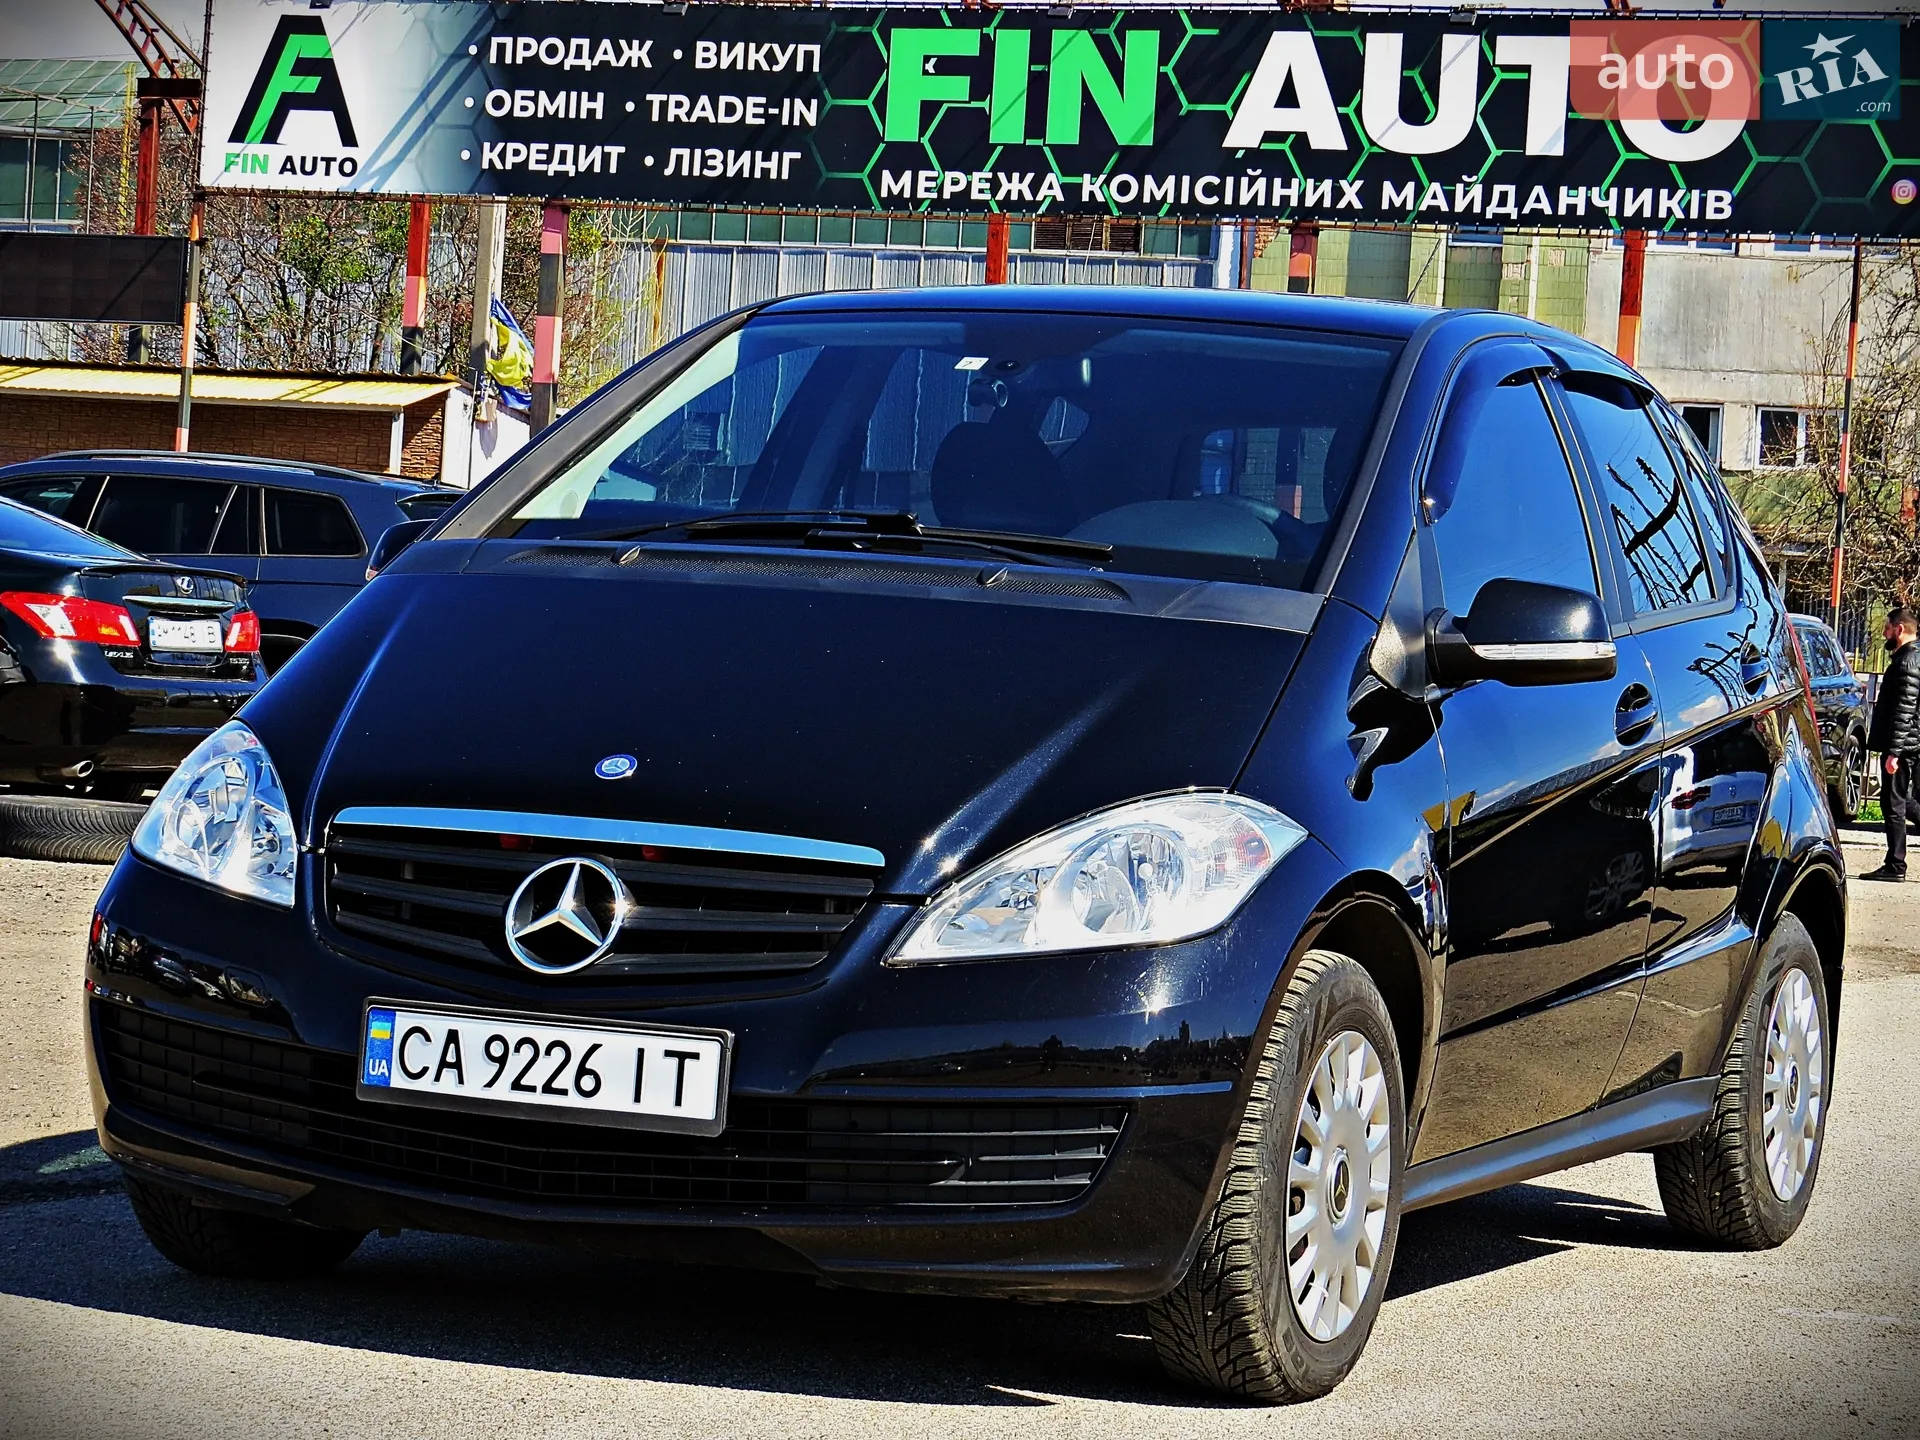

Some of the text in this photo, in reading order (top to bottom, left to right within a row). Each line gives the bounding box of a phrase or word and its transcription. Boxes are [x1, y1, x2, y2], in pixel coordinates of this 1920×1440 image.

[489, 36, 821, 73] ПРОДАЖ ВИКУП
[484, 89, 818, 127] ОБМІН TRADE-IN
[885, 27, 1752, 162] FIN AUTO
[224, 153, 358, 178] FIN AUTO
[481, 141, 802, 180] КРЕДИТ ЛІЗИНГ
[880, 168, 1733, 220] МЕРЕЖА КОМІСІЙНИХ МАЙДАНЧИКІВ
[368, 1058, 389, 1077] UA
[398, 1026, 701, 1107] CA 9226 IT
